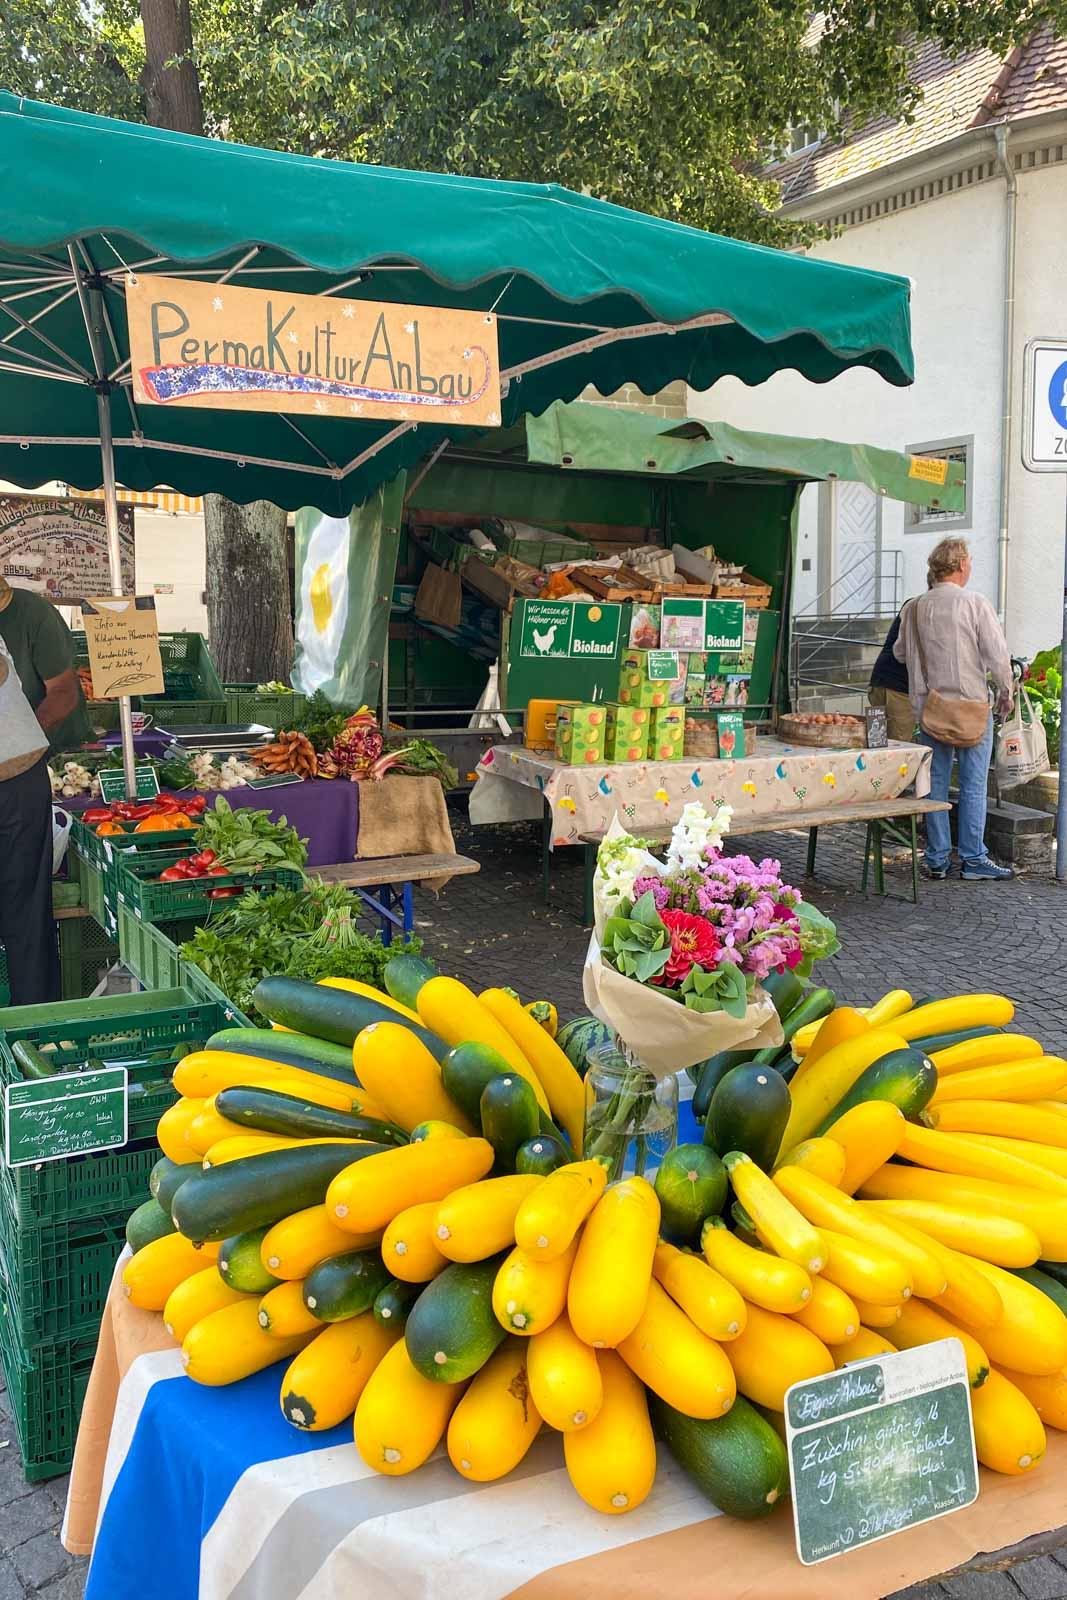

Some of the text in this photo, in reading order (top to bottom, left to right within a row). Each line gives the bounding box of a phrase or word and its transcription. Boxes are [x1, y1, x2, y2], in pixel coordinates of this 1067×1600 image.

[1054, 437, 1067, 455] Z
[528, 605, 570, 616] Wir lassen die
[94, 617, 114, 630] Info
[527, 615, 551, 624] Hühner
[573, 639, 614, 654] Bioland
[707, 635, 741, 648] Bioland
[43, 1115, 56, 1130] kg
[58, 1136, 69, 1146] kg
[801, 1425, 868, 1471] Zucchini
[817, 1470, 838, 1504] kg
[934, 1498, 955, 1511] Klasse
[811, 1539, 840, 1556] Herkunft
